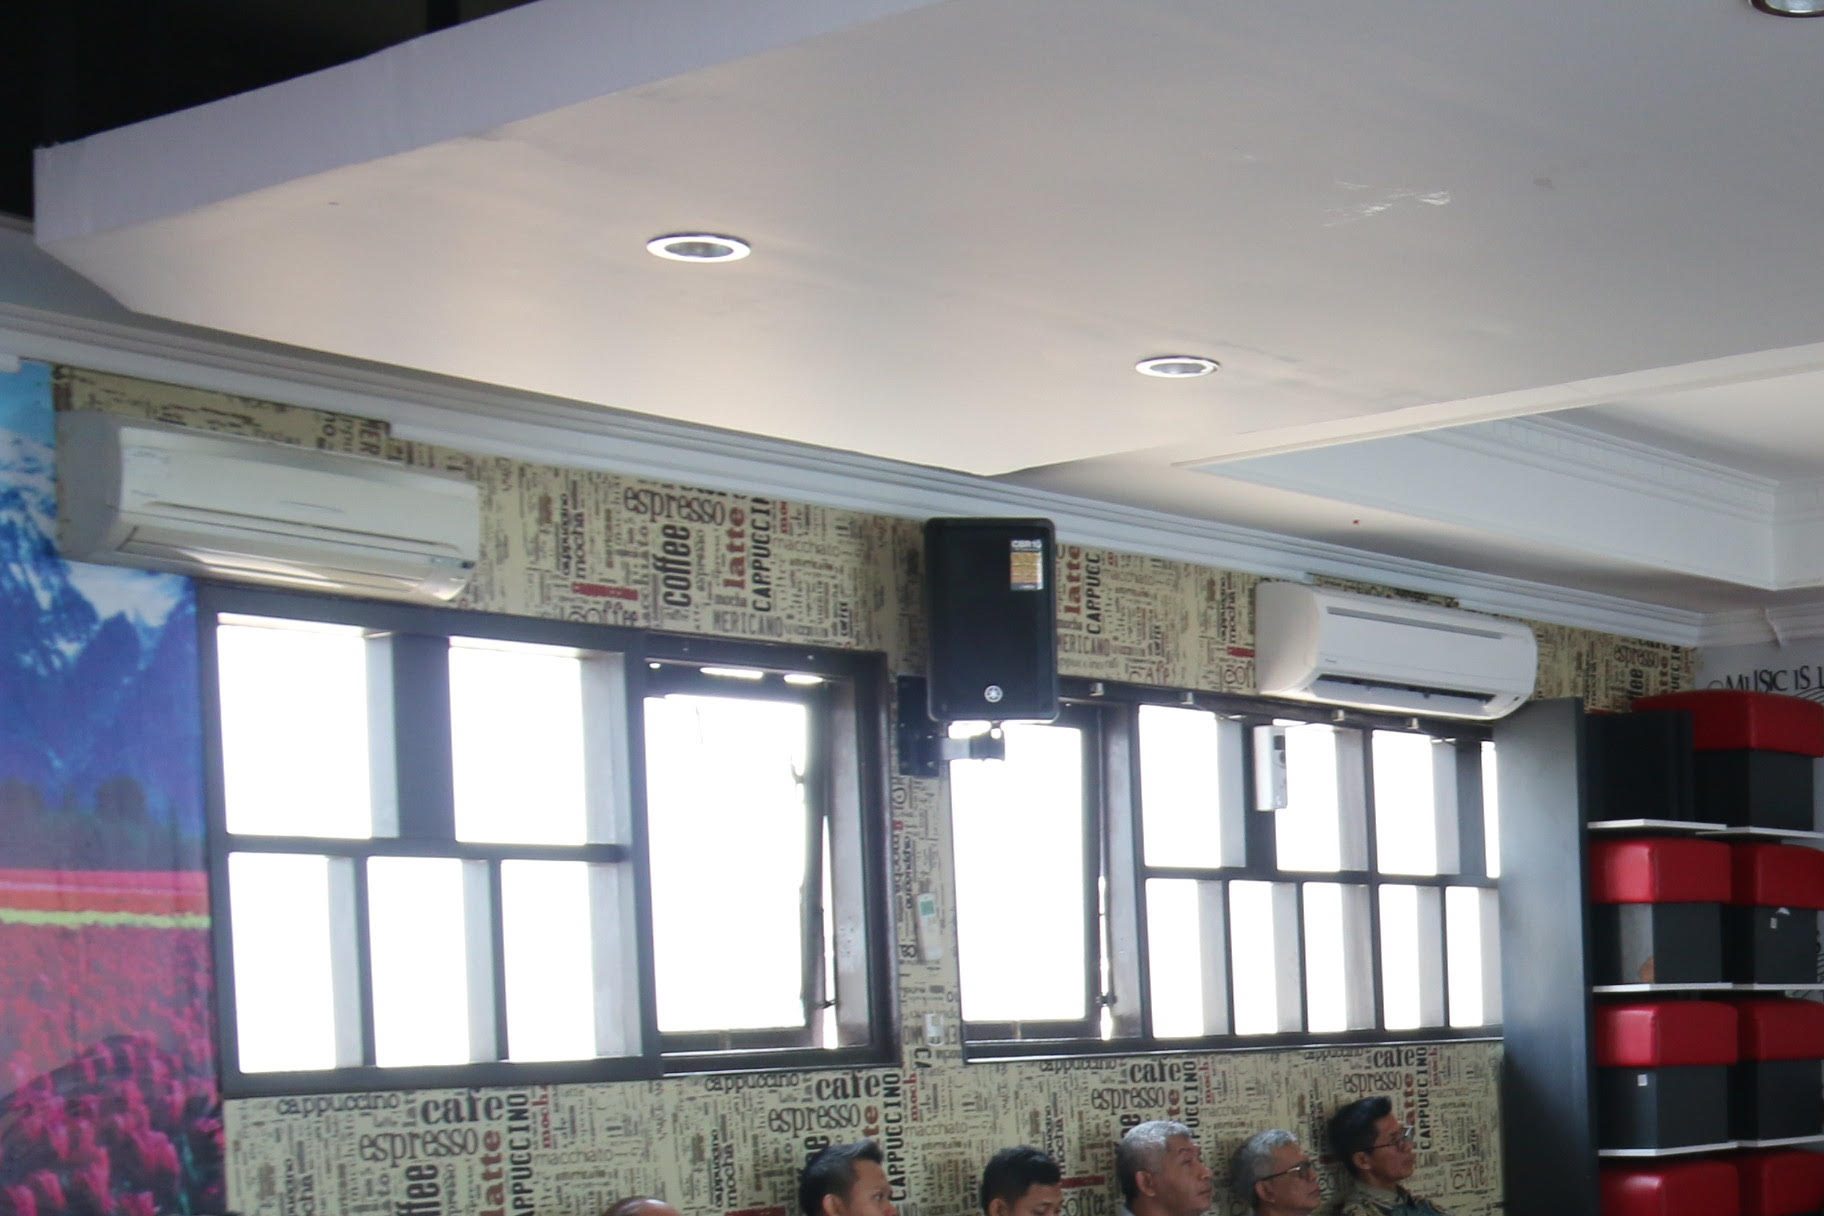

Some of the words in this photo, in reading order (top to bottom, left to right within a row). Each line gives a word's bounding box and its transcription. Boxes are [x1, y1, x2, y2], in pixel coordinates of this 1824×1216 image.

[623, 486, 726, 526] espresso
[653, 524, 691, 608] coffee
[723, 507, 746, 589] latte
[752, 497, 772, 612] CAPPUCCI
[1085, 553, 1101, 635] CAPPUCC
[1794, 664, 1811, 690] IS
[277, 1093, 400, 1117] cappuccino
[903, 1072, 918, 1122] moch
[1091, 1085, 1167, 1116] espresso
[1343, 1073, 1402, 1098] espresso
[1416, 1047, 1431, 1151] CAPPUCCINO
[531, 1085, 551, 1149] moch
[768, 1104, 861, 1139] espresso
[883, 1073, 908, 1202] CAPPUCCINO
[359, 1127, 479, 1168] espresso
